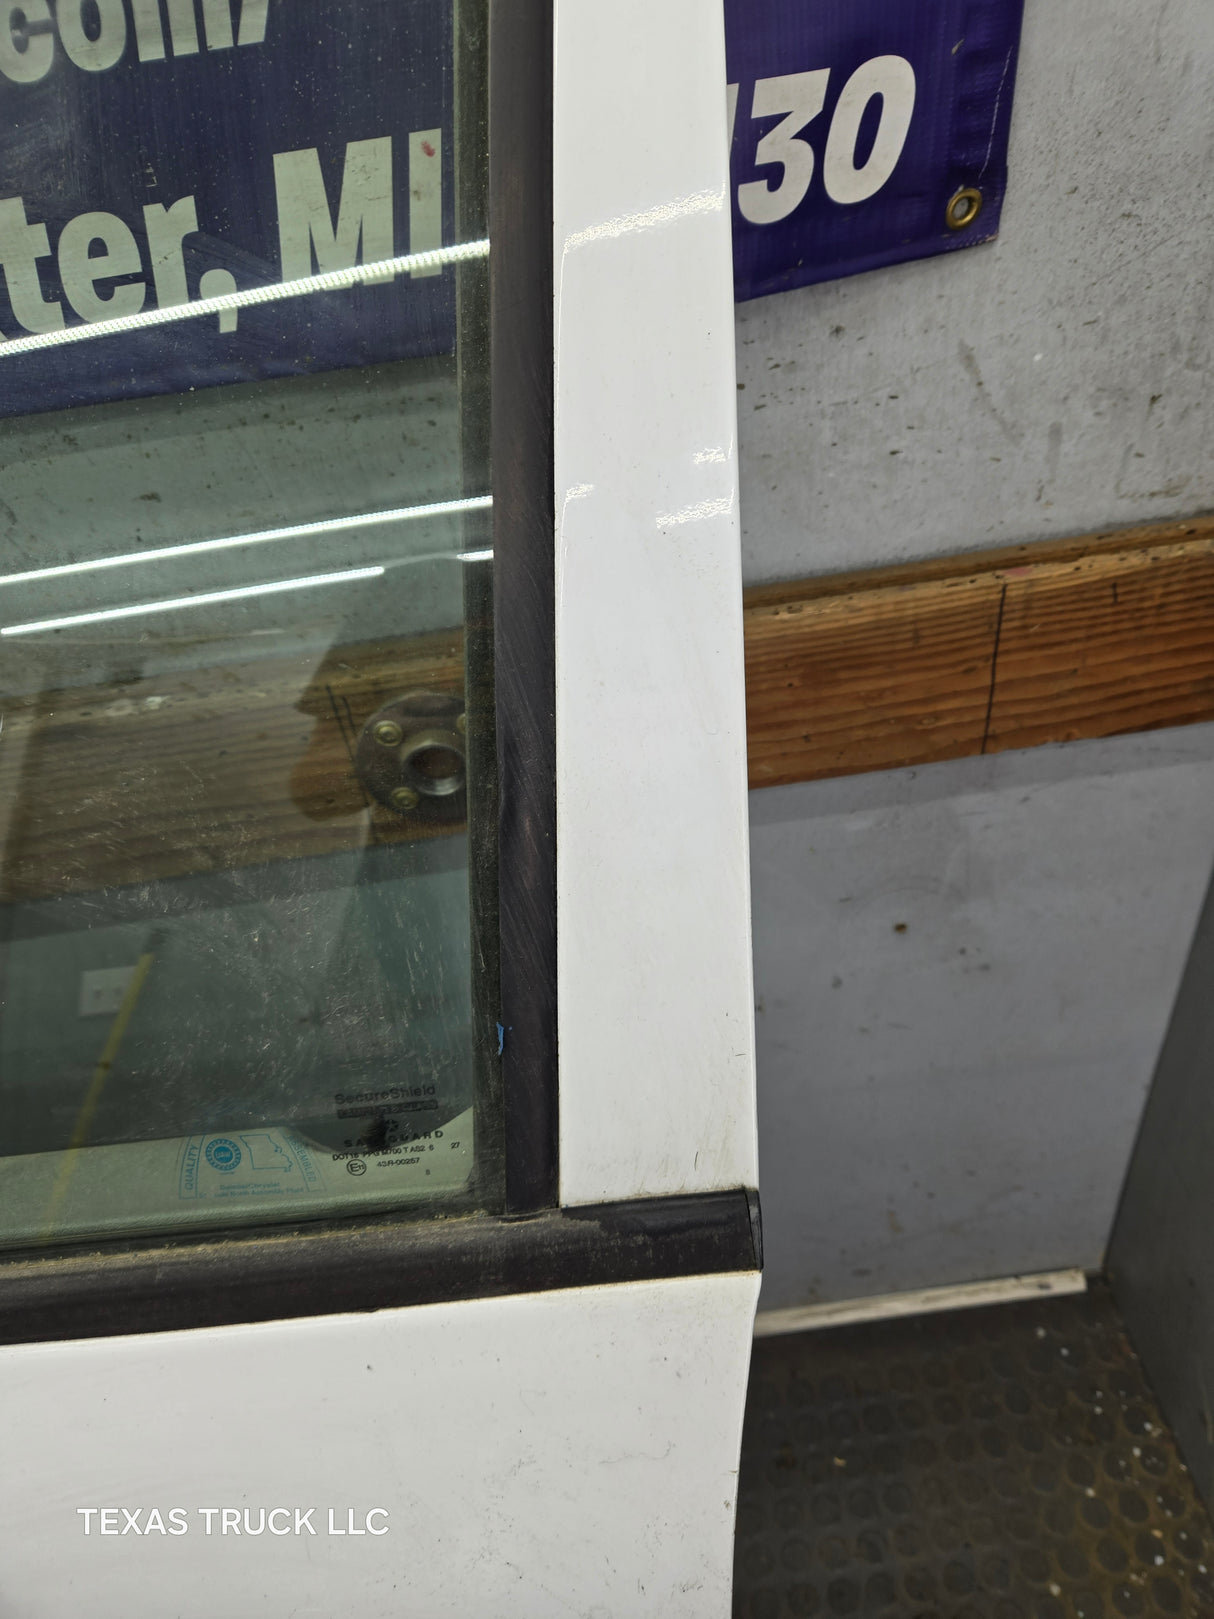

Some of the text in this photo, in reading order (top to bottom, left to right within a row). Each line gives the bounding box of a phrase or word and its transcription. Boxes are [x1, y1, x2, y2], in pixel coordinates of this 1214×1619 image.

[0, 54, 916, 338] ter, MI 30
[334, 1084, 436, 1104] SecureShield
[343, 1130, 444, 1148] SAGUARD
[184, 1144, 200, 1191] QUALITY
